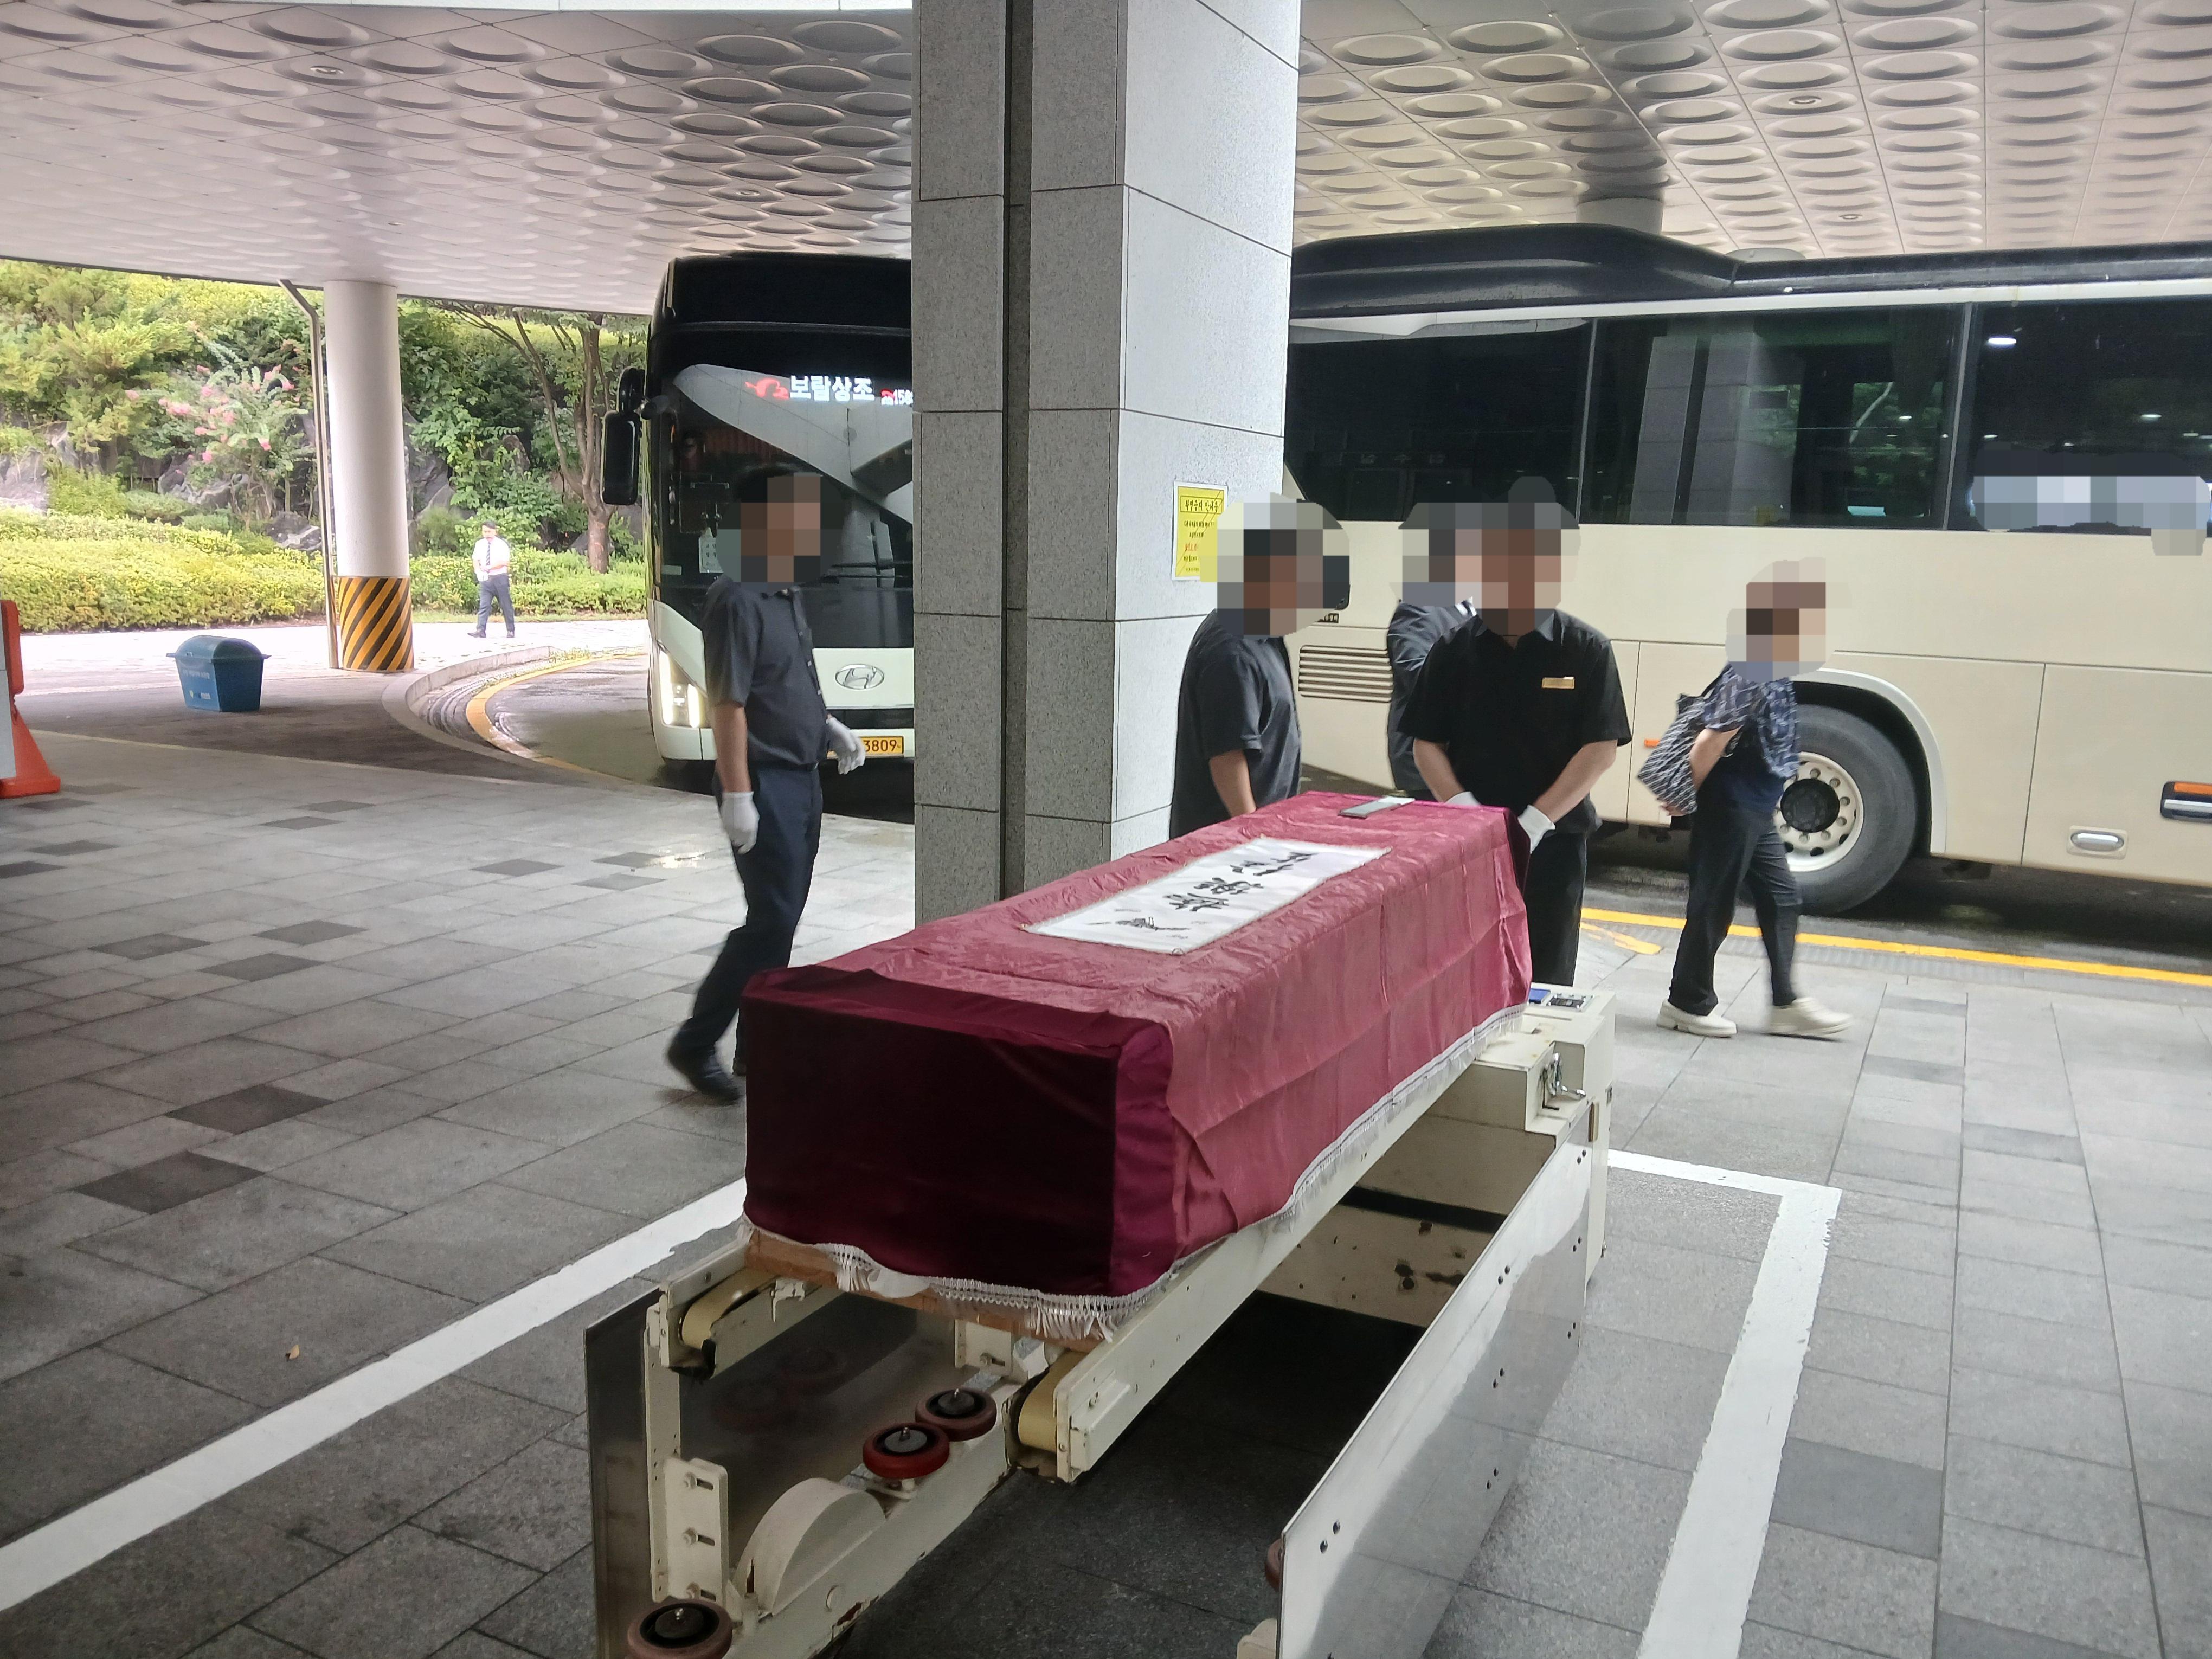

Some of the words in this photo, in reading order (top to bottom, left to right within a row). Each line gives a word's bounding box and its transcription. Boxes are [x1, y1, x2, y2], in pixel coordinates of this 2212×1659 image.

[789, 375, 875, 402] 보람상조
[1205, 500, 1218, 513] 안내문
[863, 740, 897, 752] 3809
